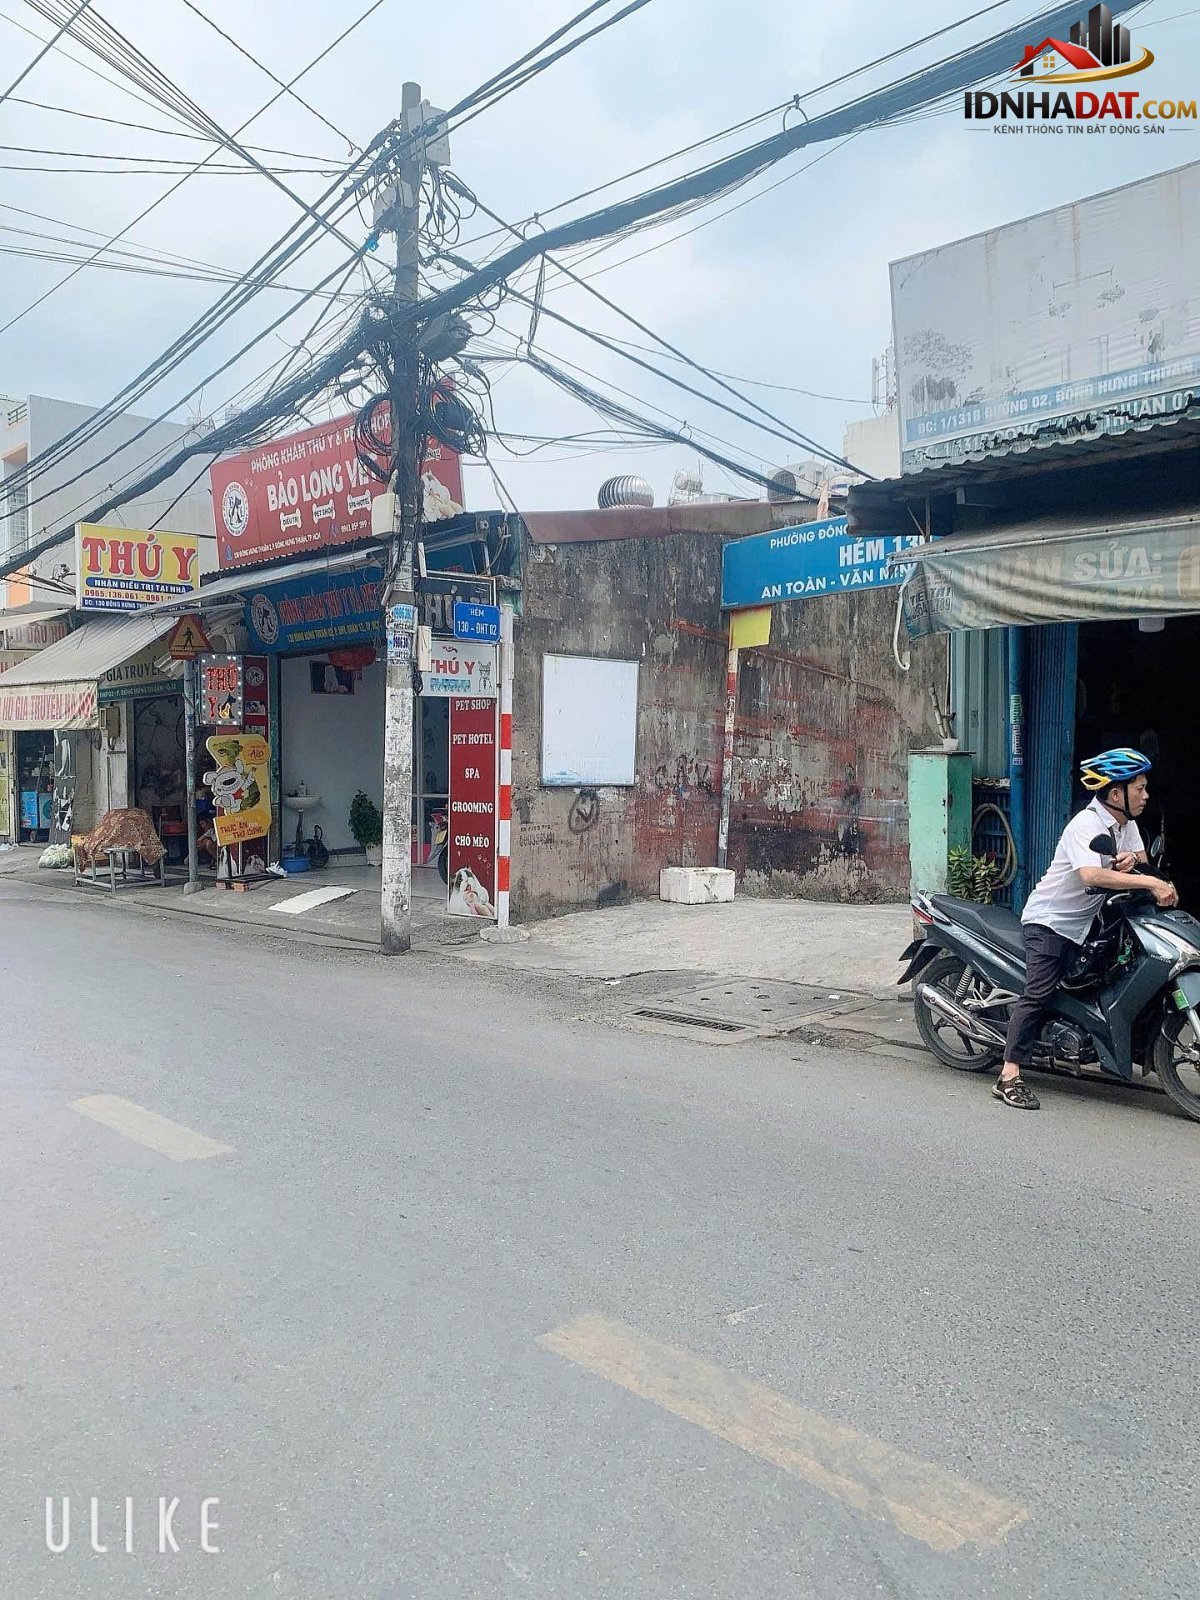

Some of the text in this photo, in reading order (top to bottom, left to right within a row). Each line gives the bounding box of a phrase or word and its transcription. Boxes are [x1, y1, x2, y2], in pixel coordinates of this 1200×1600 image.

[941, 409, 981, 429] 1/131B
[250, 453, 279, 474] PHÒNG
[280, 440, 306, 467] KHÁM
[326, 434, 334, 449] Y
[266, 471, 299, 512] BẢO
[301, 464, 344, 503] LONG
[770, 530, 816, 550] PHƯỜNG
[82, 533, 196, 581] THÚ Y
[840, 537, 885, 568] HẺM
[94, 579, 119, 589] NHẬN
[120, 580, 139, 591] ĐIỀU
[761, 583, 781, 599] AN
[786, 576, 827, 596] TOÀN
[839, 568, 874, 587] VĂN
[457, 620, 469, 633] 130
[476, 622, 489, 635] ĐHT
[489, 624, 497, 636] 02
[107, 668, 122, 682] GIA
[464, 661, 475, 675] Y
[207, 661, 237, 718] THÚ Y
[455, 698, 491, 711] PET SHOP
[452, 733, 494, 745] PET HOTEL
[464, 768, 480, 779] SPA
[452, 801, 493, 813] GROOMING
[455, 832, 490, 848] CHÓ MÈO
